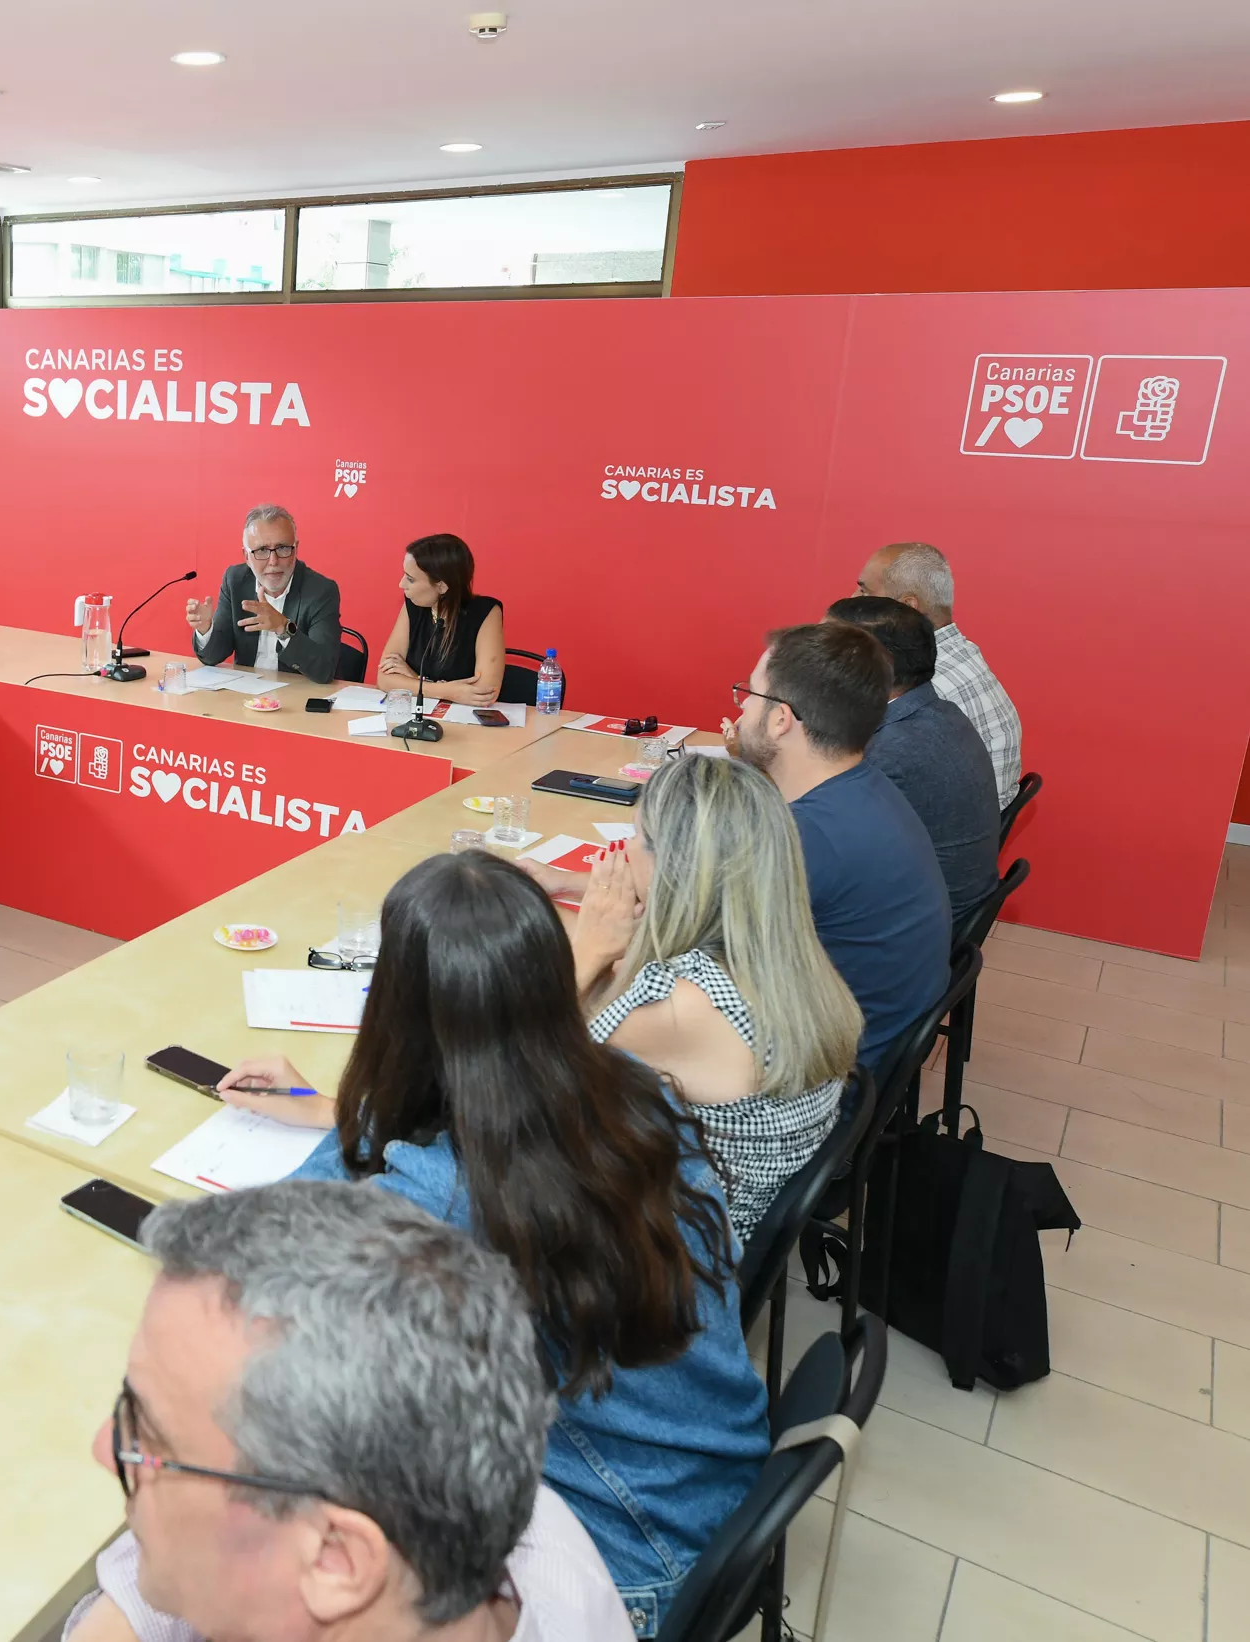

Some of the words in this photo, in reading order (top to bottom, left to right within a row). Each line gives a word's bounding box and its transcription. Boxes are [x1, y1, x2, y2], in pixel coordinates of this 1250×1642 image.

[25, 348, 146, 371] CANARIAS
[154, 348, 183, 372] ES
[986, 362, 1076, 382] Canarias
[980, 384, 1073, 415] PSOE
[335, 459, 367, 469] Canarias
[604, 465, 681, 479] CANARIAS
[685, 469, 704, 481] ES
[334, 469, 367, 484] PSOE
[40, 729, 73, 745] Canarias
[40, 740, 73, 761] PSOE
[132, 743, 235, 778] CANARIAS
[241, 764, 267, 785] ES
